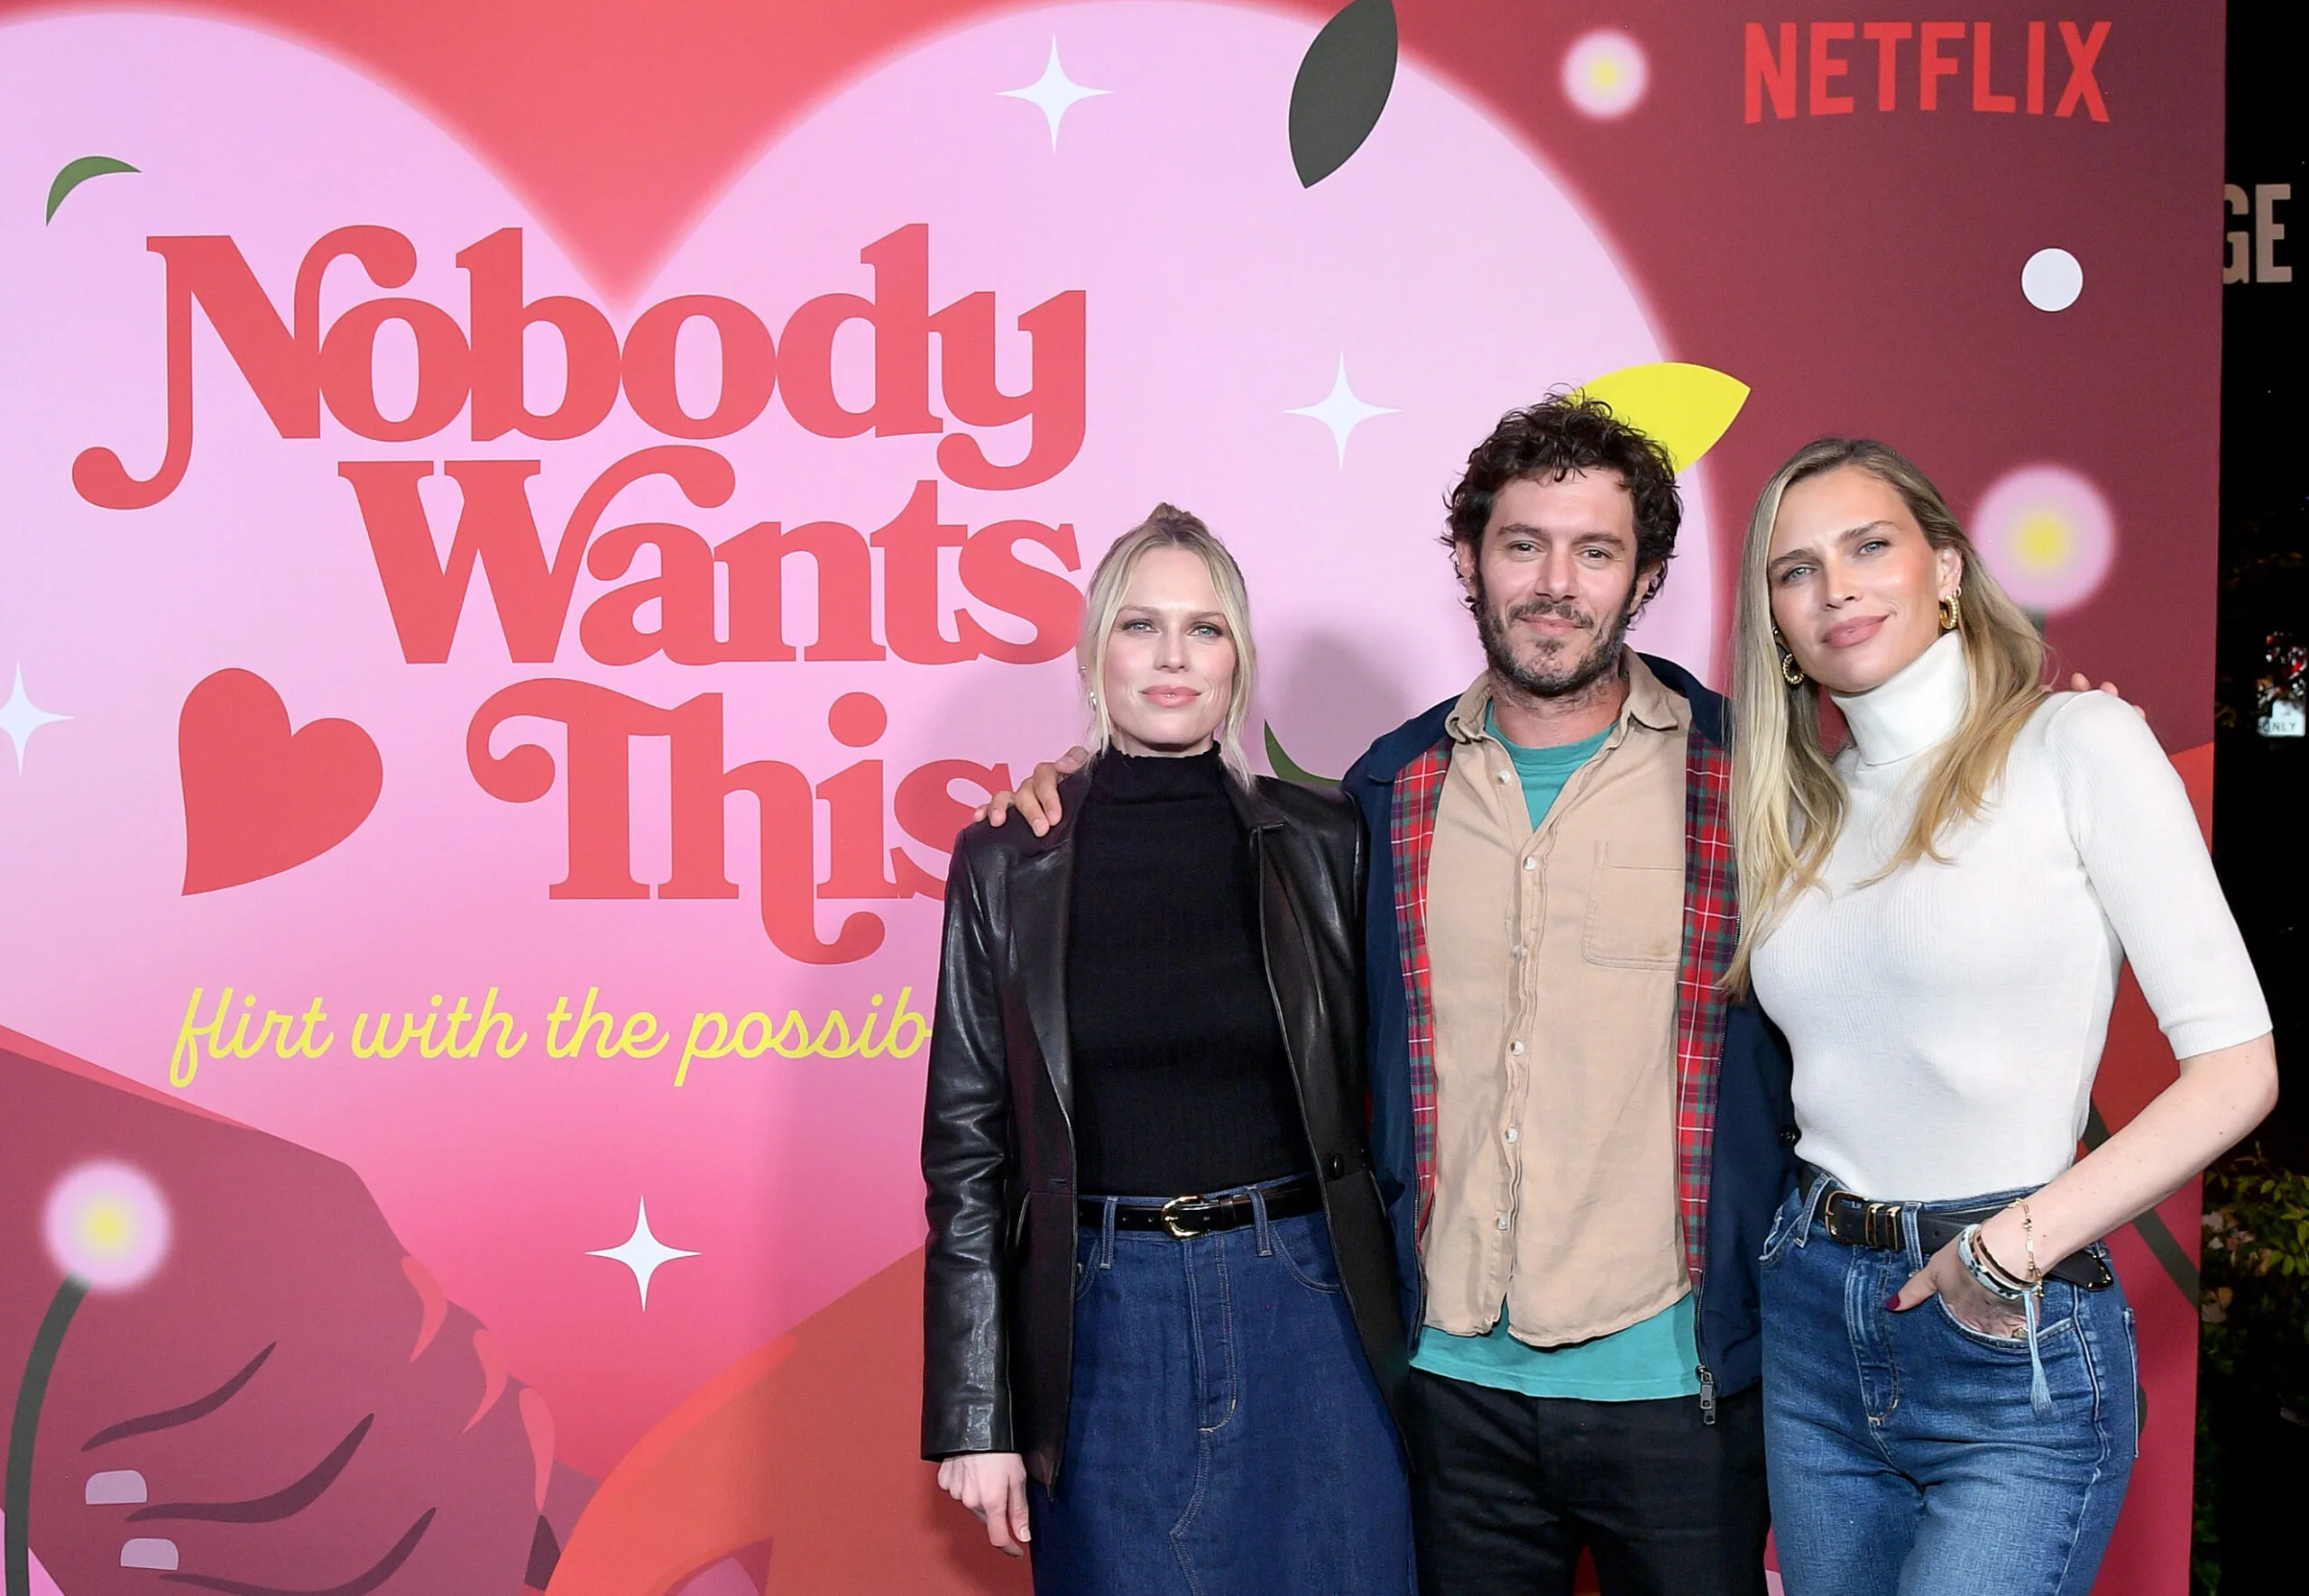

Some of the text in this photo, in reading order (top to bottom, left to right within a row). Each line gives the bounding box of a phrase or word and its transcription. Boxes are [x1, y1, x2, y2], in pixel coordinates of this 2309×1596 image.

[1744, 21, 2112, 124] NETFLIX
[72, 224, 1086, 510] Nobody
[338, 445, 1086, 665] Wants
[465, 677, 1016, 965] This
[170, 986, 334, 1087] flirt
[351, 986, 527, 1059] with
[546, 986, 669, 1058] the
